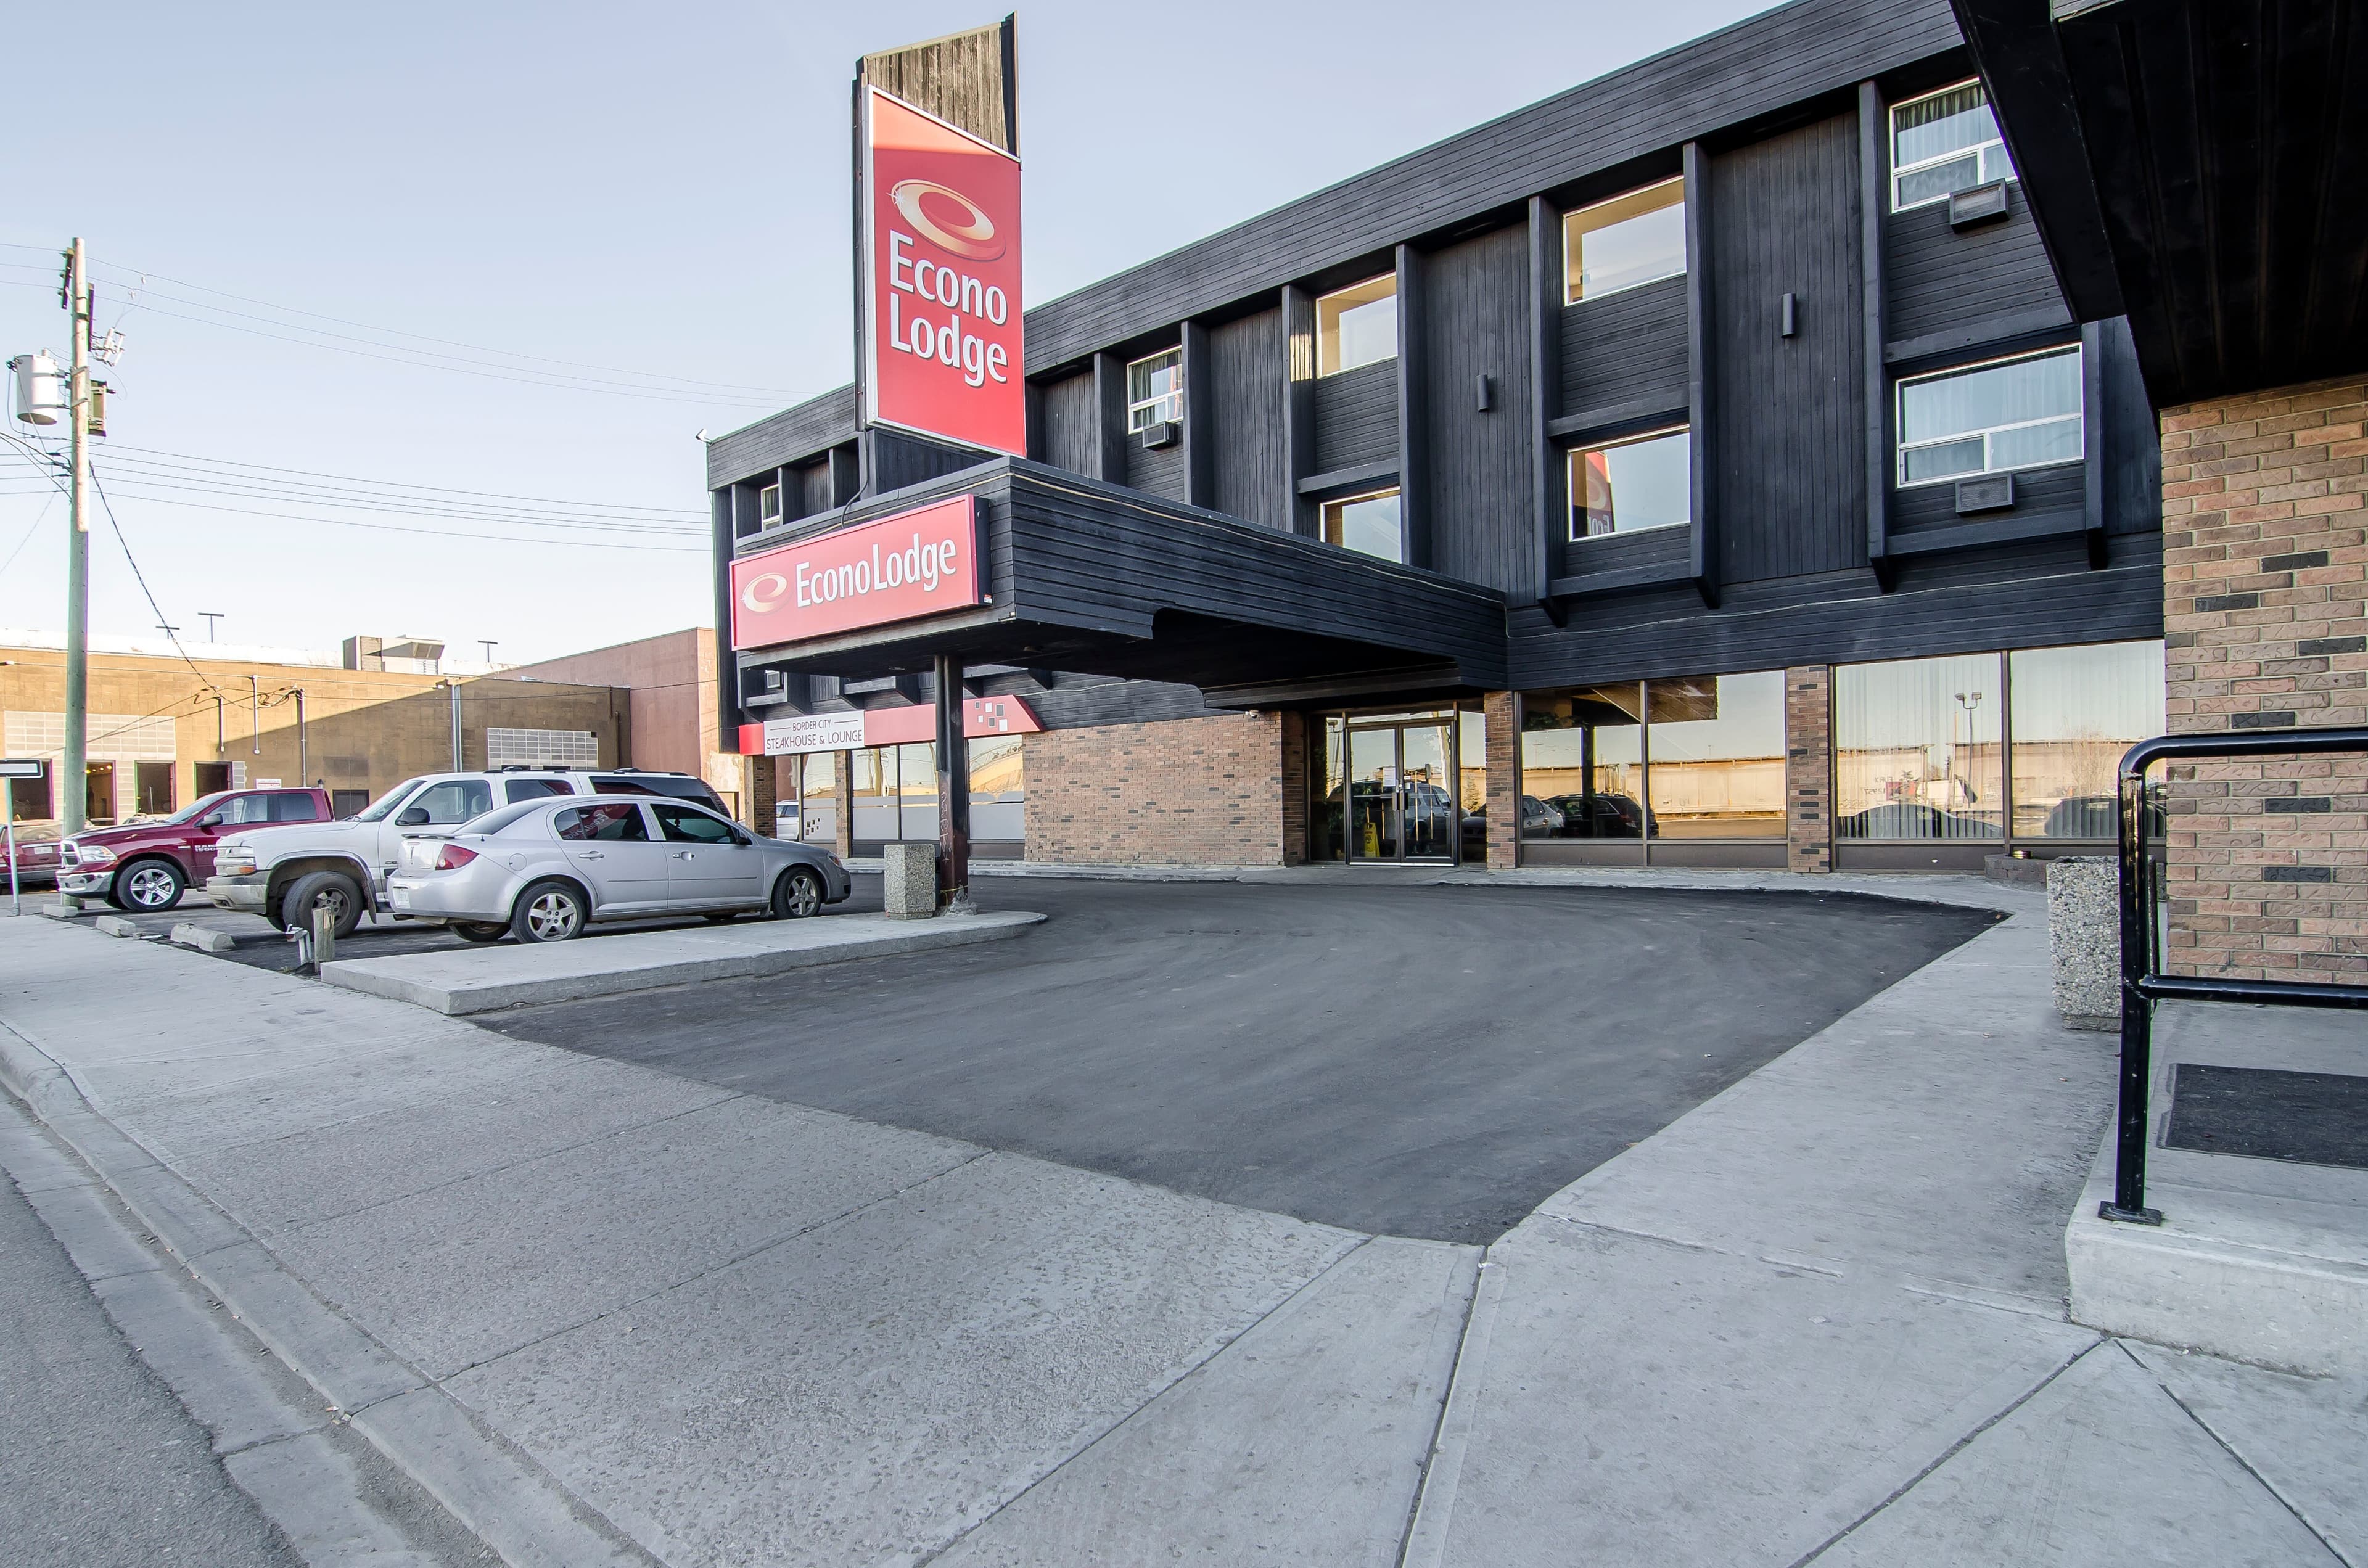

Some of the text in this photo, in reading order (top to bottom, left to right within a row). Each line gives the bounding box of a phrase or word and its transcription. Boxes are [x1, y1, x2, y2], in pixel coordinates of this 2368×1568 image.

[889, 229, 1008, 327] Econo
[890, 293, 1008, 387] Lodge
[796, 533, 957, 608] EconoLodge
[766, 729, 863, 750] STEAKHOUSE & LOUNGE
[792, 719, 832, 731] BORDER CITY
